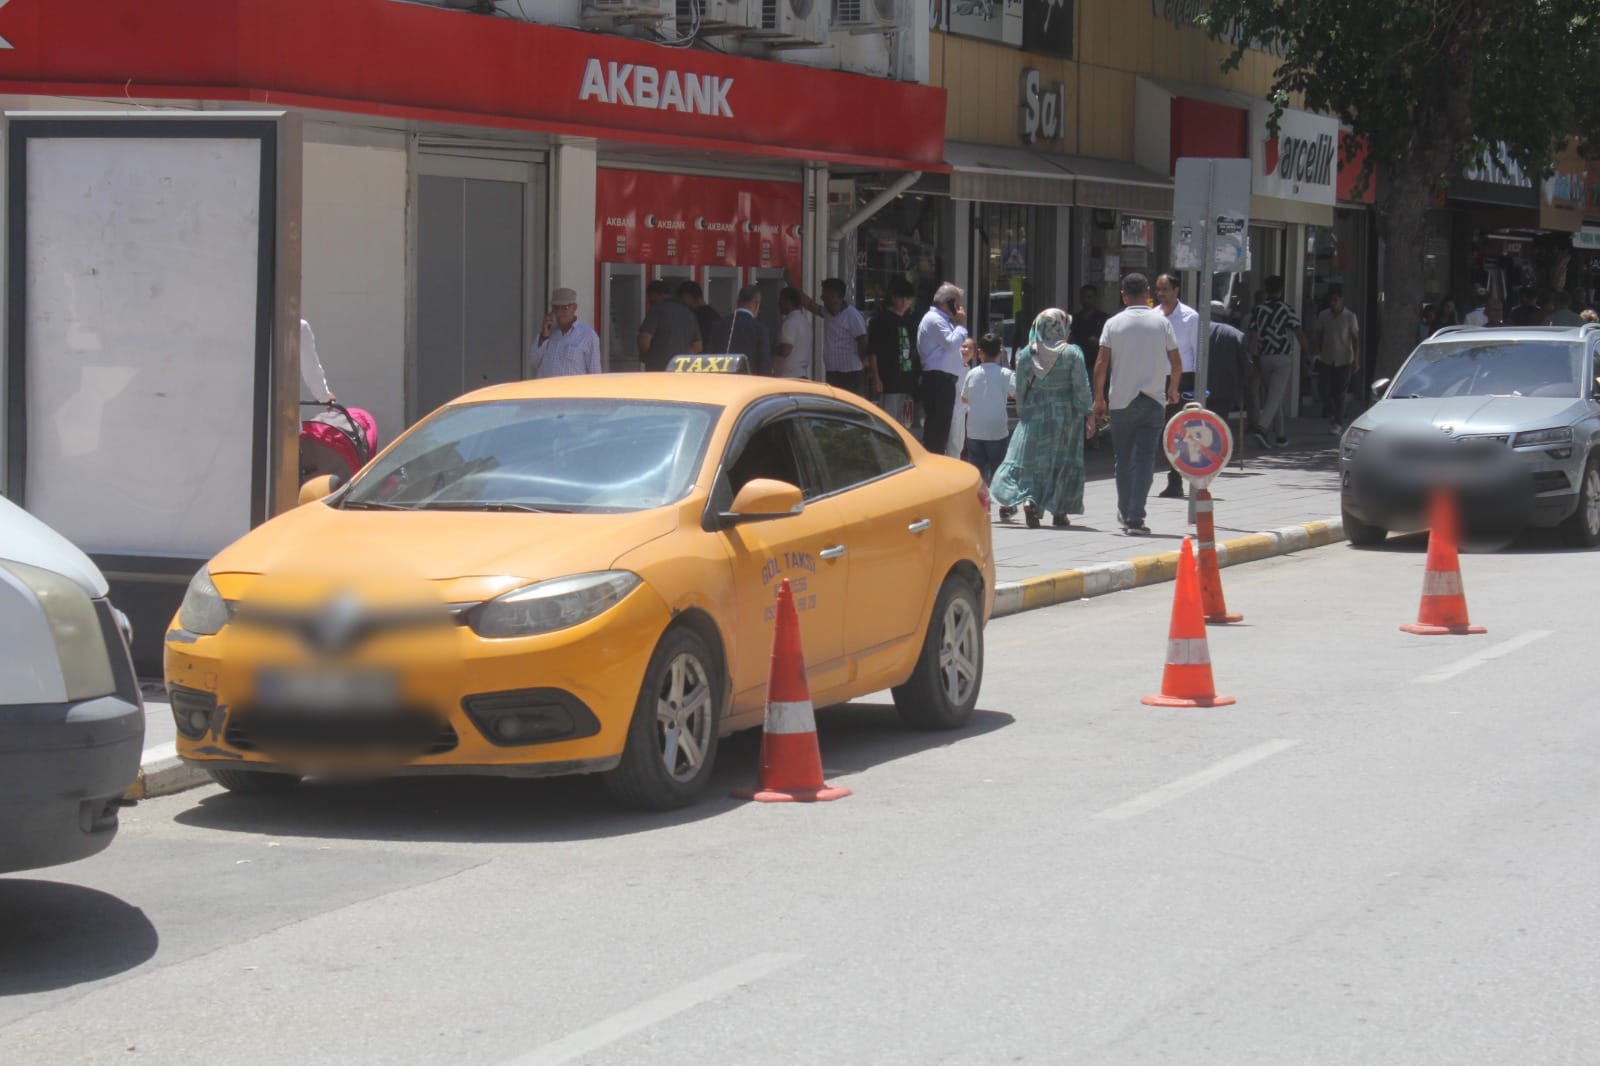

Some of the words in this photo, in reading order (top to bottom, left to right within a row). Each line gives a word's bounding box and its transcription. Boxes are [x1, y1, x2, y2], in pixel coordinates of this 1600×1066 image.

[579, 58, 734, 118] AKBANK
[657, 220, 686, 230] AKBANK
[674, 356, 733, 373] TAXI
